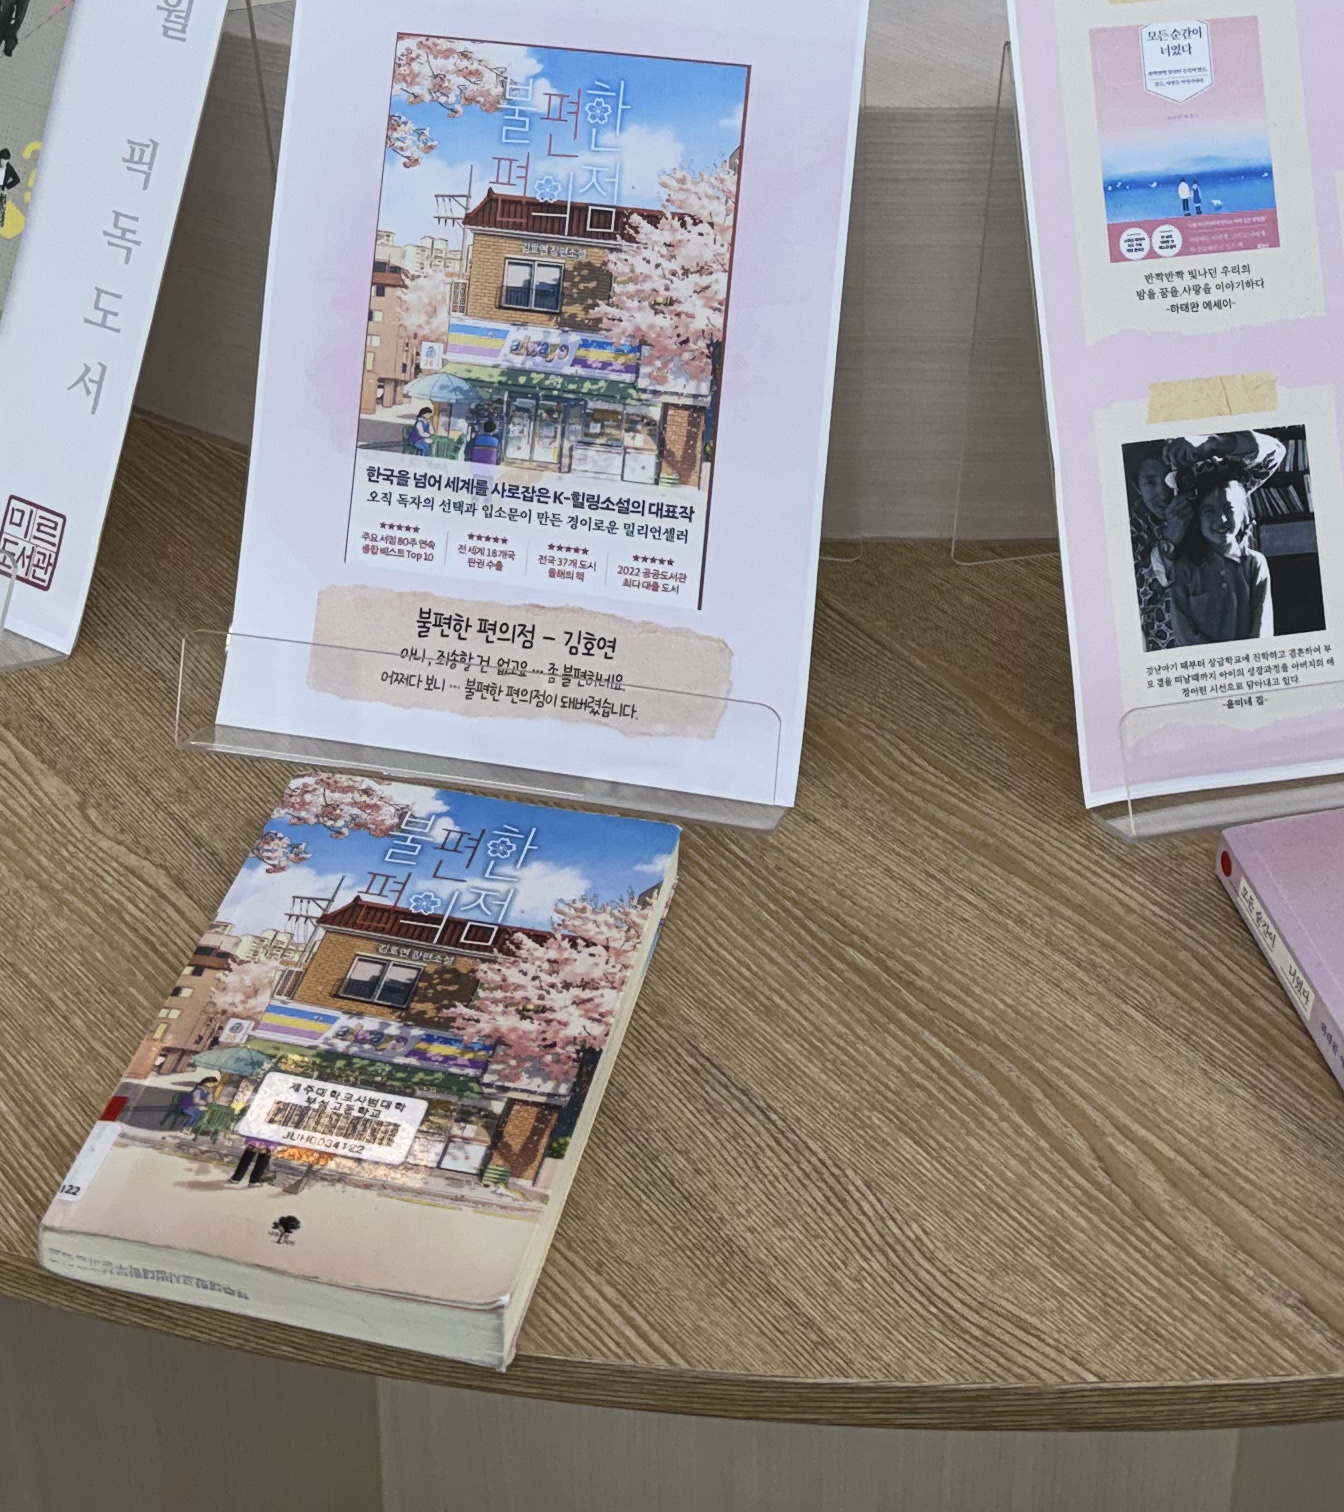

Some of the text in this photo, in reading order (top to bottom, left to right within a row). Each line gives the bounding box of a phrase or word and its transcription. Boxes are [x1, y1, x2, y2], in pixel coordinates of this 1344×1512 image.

[499, 76, 631, 158] 불편한
[489, 152, 619, 236] 편의점
[366, 465, 695, 522] 한국을 넘어 세계를 사로잡은 K-힐링소설의 대표작
[366, 490, 688, 544] 오직 독자의 선택과 입소문이 만든 경이로운 밀리언셀러
[4, 500, 63, 552] 미르
[416, 607, 616, 659] 불편한 편의점 김호연
[380, 670, 637, 720] 어쩌다 보니 불편한 편의점이 돼버렸습니다.
[399, 643, 627, 694] 아니, 죄송할 건 없고요 좀 불편하네요.
[384, 813, 538, 884] 불편한
[357, 870, 517, 946] 편의점
[289, 1082, 406, 1112] 제주대학교사범대학
[300, 1095, 382, 1118] 부설고등학교
